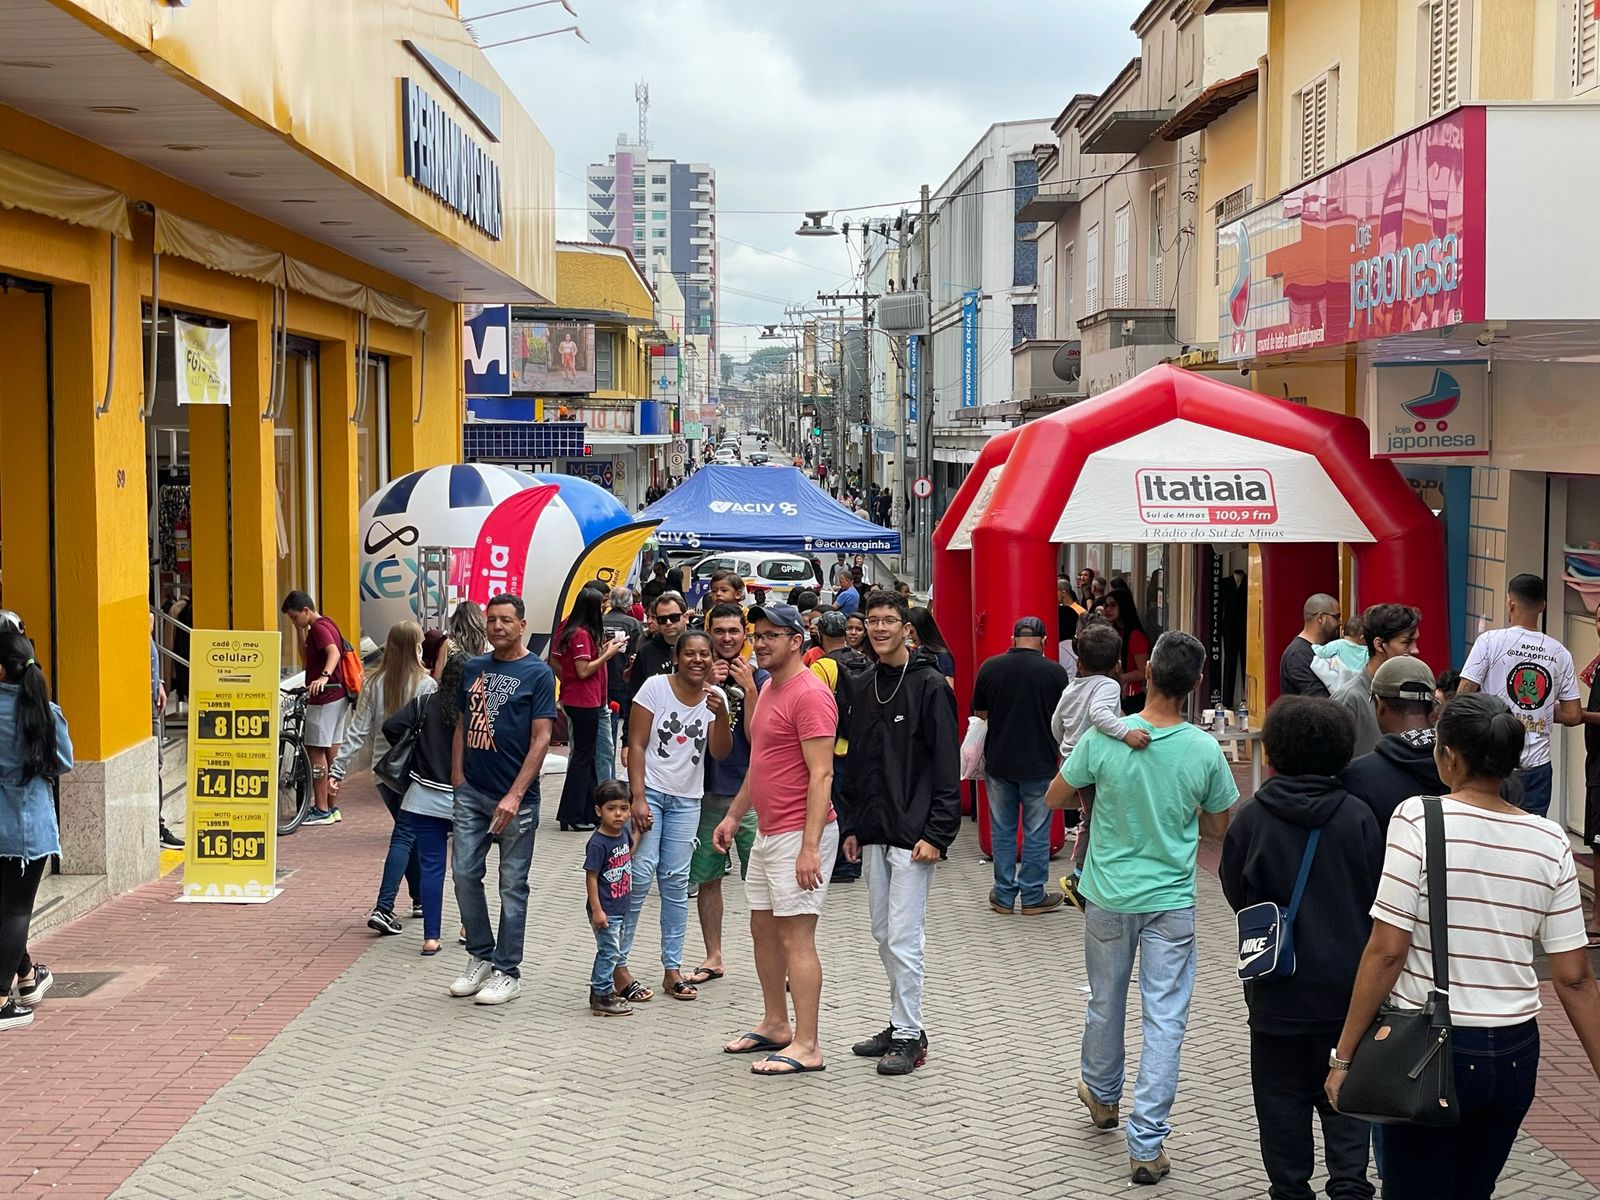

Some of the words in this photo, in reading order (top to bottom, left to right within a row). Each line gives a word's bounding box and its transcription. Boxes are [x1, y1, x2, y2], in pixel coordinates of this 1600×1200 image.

[1349, 233, 1458, 328] japonesa
[1395, 425, 1412, 435] loja
[1387, 432, 1476, 452] japonesa
[570, 464, 612, 475] META
[1143, 474, 1267, 501] Itatiaia
[731, 503, 775, 513] ACIV
[779, 502, 798, 516] 95
[1146, 511, 1160, 519] Sul
[1163, 511, 1174, 519] de
[1176, 511, 1206, 519] Minas
[1215, 510, 1250, 521] 100,9
[1252, 510, 1271, 520] fm
[650, 532, 684, 542] ACIV
[1140, 529, 1150, 537] A
[1153, 528, 1188, 538] Rádio
[1190, 528, 1205, 537] do
[1208, 528, 1228, 538] Sul
[1230, 528, 1245, 538] de
[1249, 529, 1284, 538] Minas
[815, 539, 891, 551] @aciv.varginha
[481, 545, 510, 601] aia
[1507, 649, 1557, 664] @ZACAOFICIAL
[1521, 644, 1546, 653] APOIO:
[212, 653, 259, 663] celular?
[468, 673, 521, 695] NEVER
[469, 691, 509, 712] STOP
[215, 716, 227, 737] 8
[237, 715, 262, 736] 99
[467, 729, 496, 751] RUN
[201, 775, 227, 795] 1.4
[236, 775, 262, 795] 99
[201, 835, 228, 856] 1.6
[232, 838, 258, 858] 99
[1240, 936, 1268, 955] NIKE
